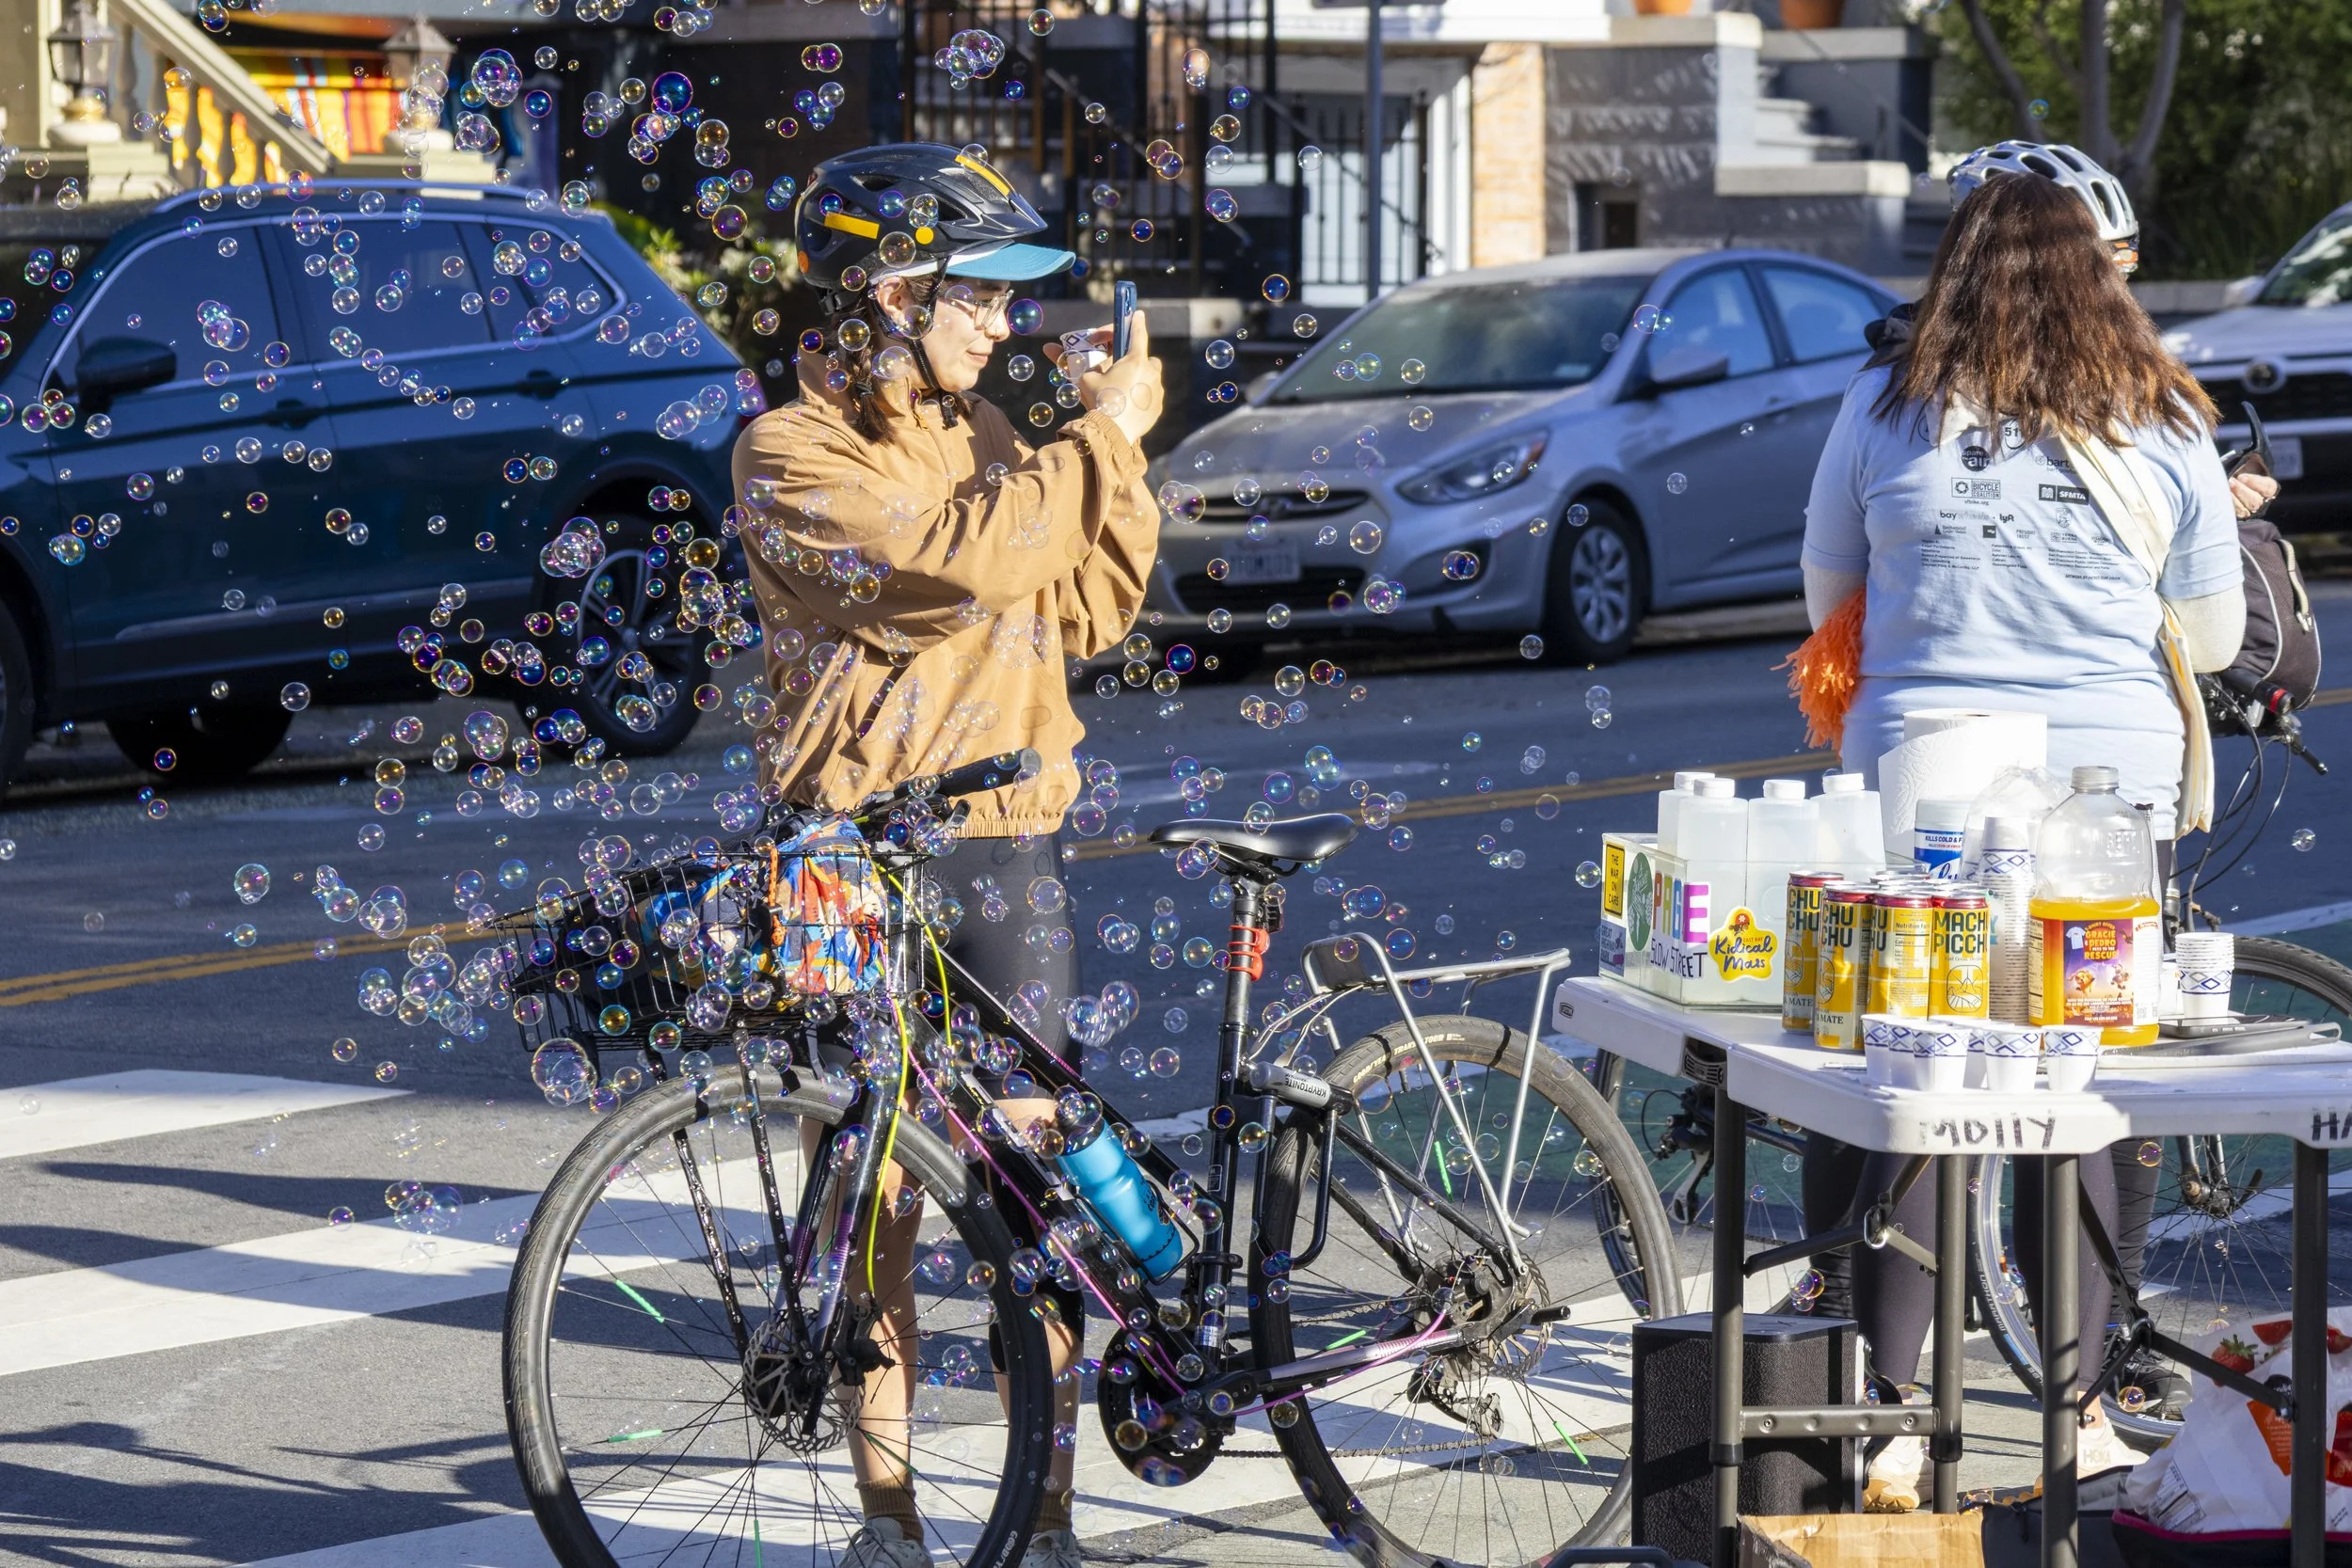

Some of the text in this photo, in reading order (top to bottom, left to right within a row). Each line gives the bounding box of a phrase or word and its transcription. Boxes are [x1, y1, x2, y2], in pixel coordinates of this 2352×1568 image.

[2005, 427, 2019, 436] 51
[2046, 456, 2069, 467] bart
[2059, 490, 2086, 500] SFMTA
[1999, 514, 2014, 523] lyft
[1611, 854, 1619, 866] THE
[1611, 867, 1619, 879] WAR
[1611, 882, 1617, 892] ON
[1608, 894, 1619, 907] CARS
[1653, 872, 1709, 943] PAGE
[2085, 930, 2116, 939] GRACIE
[1715, 935, 1773, 955] Kidical
[1650, 938, 1708, 978] SLOW STREET
[1724, 956, 1766, 973] Mass
[1788, 997, 1814, 1007] MATE
[1820, 1015, 1844, 1024] MATE
[1353, 1054, 1387, 1083] GOODYEA
[1424, 1034, 1444, 1045] TOUR
[1285, 1078, 1327, 1098] KRYPTONITE
[1979, 1274, 2006, 1332] MARATHON
